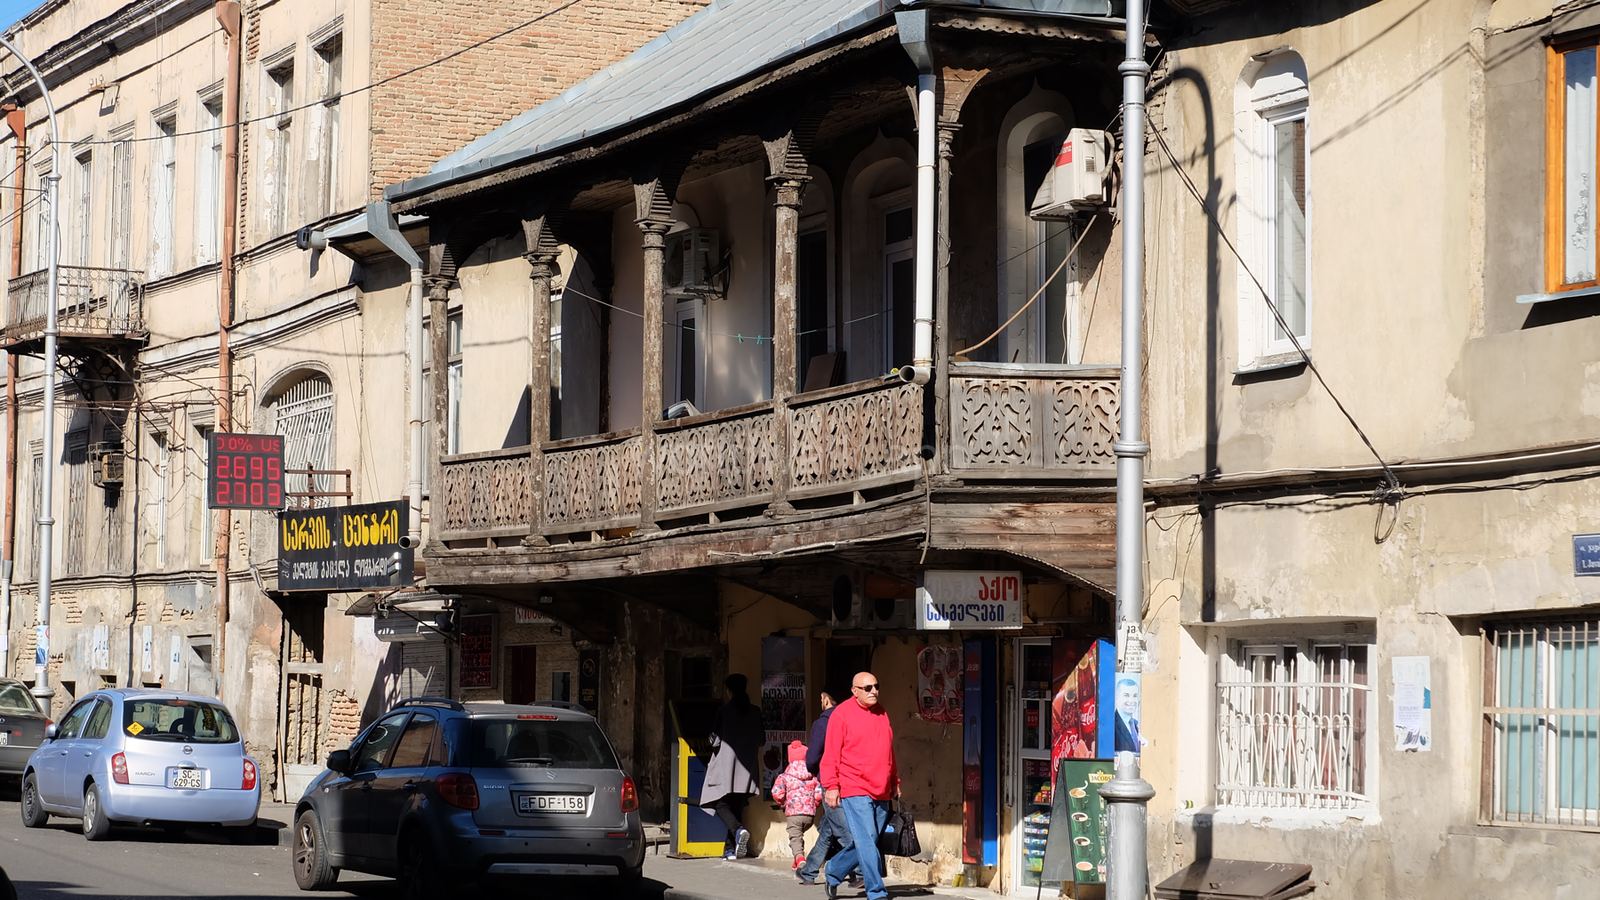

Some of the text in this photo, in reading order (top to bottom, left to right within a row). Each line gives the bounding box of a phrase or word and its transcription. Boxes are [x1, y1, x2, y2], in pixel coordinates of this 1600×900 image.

[283, 508, 398, 551] სერვის ცენტრი
[926, 602, 1004, 622] სასმელები
[528, 797, 584, 809] FDF-158
